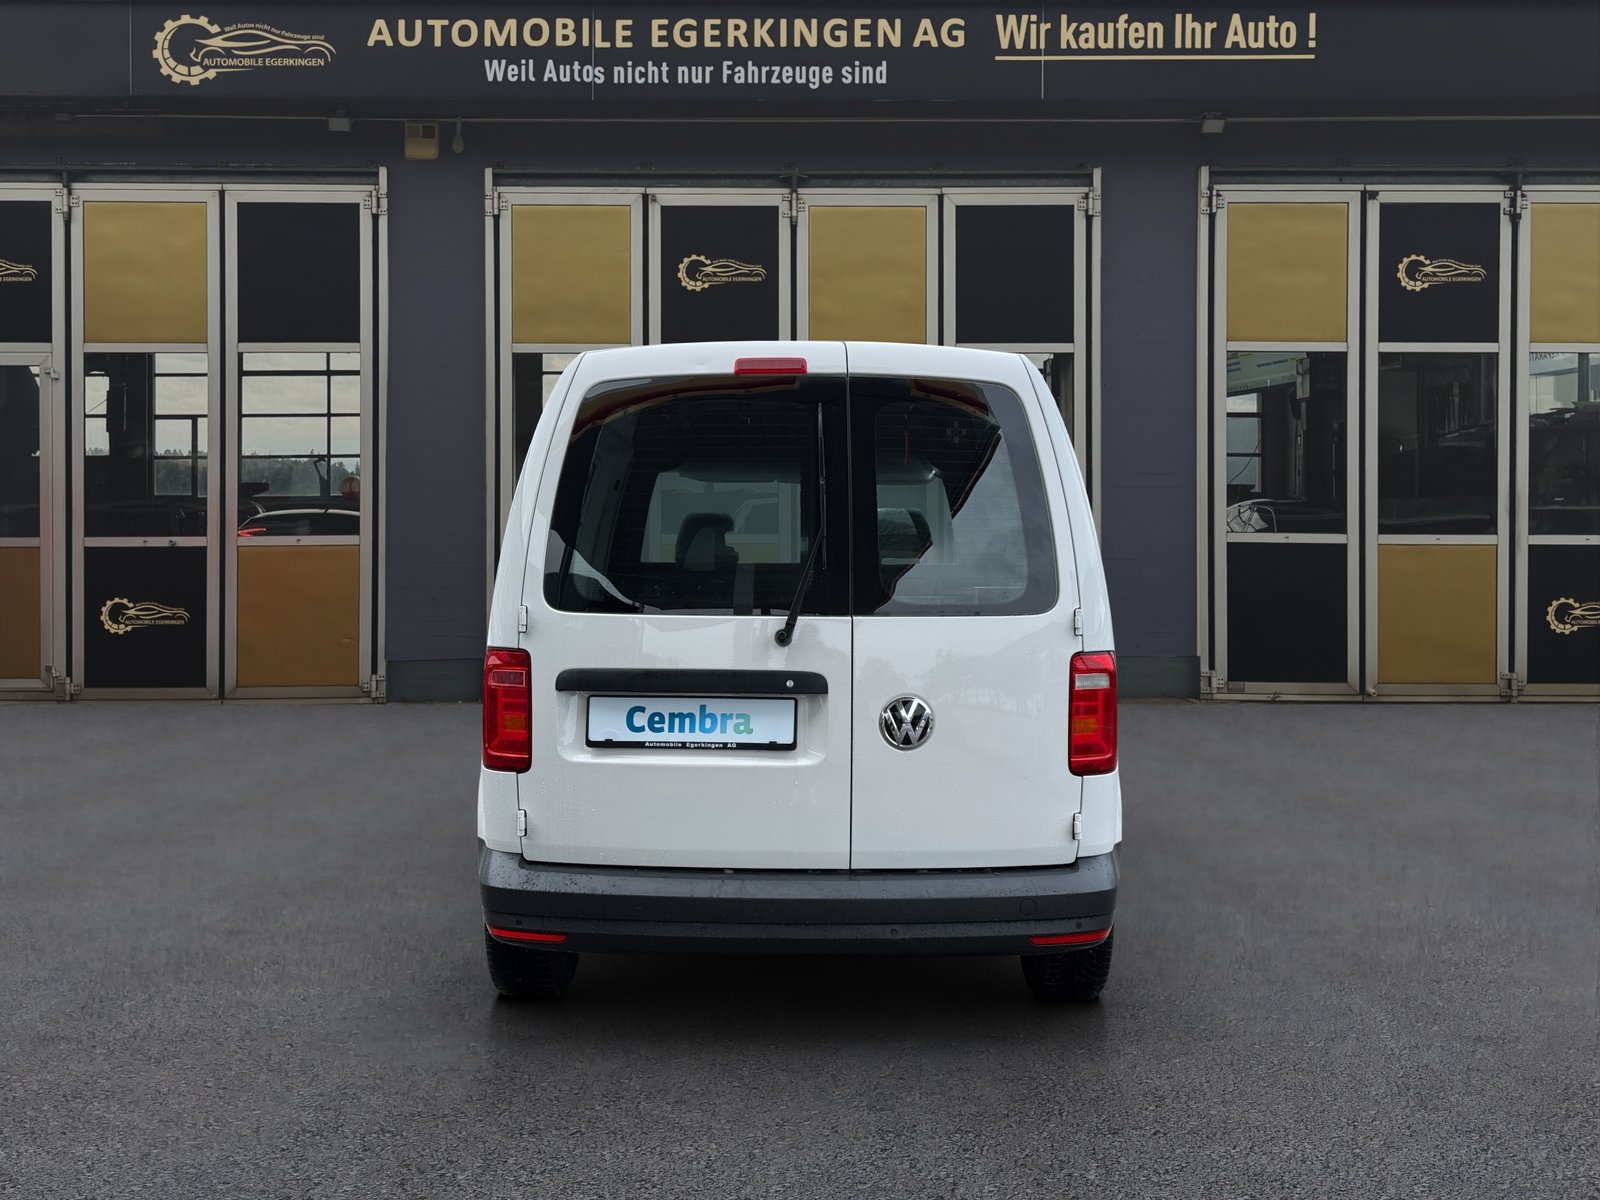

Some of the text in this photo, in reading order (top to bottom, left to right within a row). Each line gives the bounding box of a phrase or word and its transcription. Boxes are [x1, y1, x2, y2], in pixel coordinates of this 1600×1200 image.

[223, 24, 237, 32] Weil
[255, 23, 271, 31] nicht
[281, 30, 311, 41] Fahrzeuge
[367, 17, 966, 48] AUTOMOBILE EGERKINGEN AG
[995, 14, 1051, 49] Wir
[1060, 13, 1164, 49] kaufen
[1174, 13, 1217, 49] Ihr
[1224, 13, 1297, 49] Auto
[202, 57, 325, 67] AUTOMOBILE EGERKINGEN
[484, 59, 888, 90] Weil Autos nicht nur Fahrzeuge sind
[625, 704, 753, 735] Cembra
